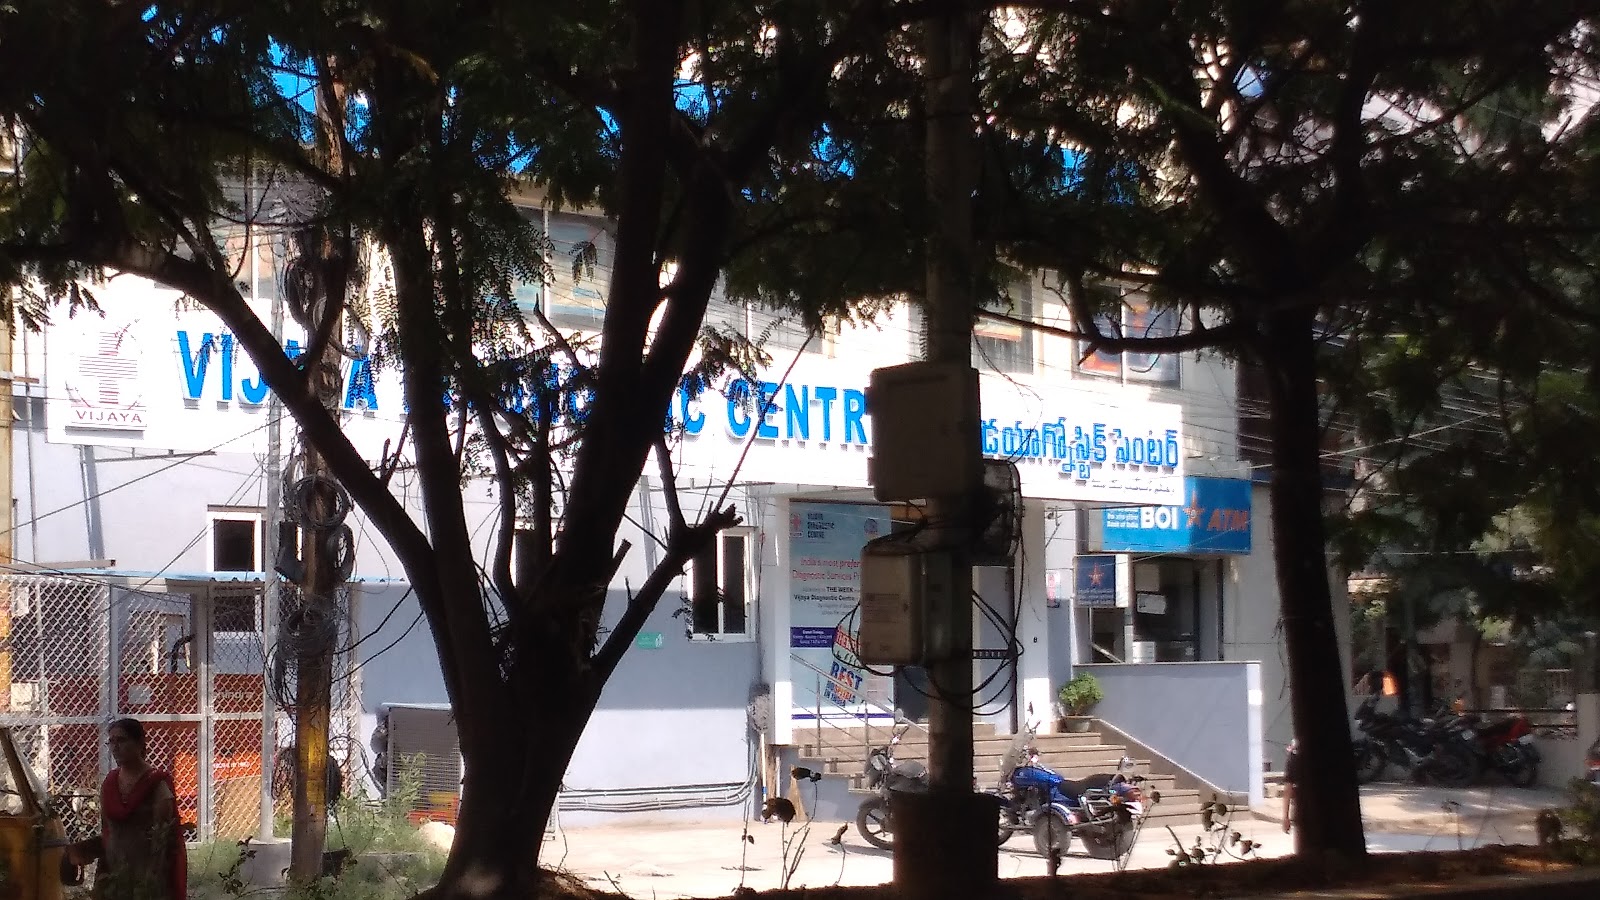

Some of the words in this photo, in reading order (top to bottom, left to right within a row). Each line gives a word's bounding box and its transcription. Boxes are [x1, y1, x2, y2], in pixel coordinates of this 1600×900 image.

[176, 331, 379, 410] VIJA
[727, 378, 868, 444] CENTR
[75, 409, 142, 423] VIJAYA
[1141, 506, 1178, 530] BOI
[1206, 509, 1249, 531] ATM
